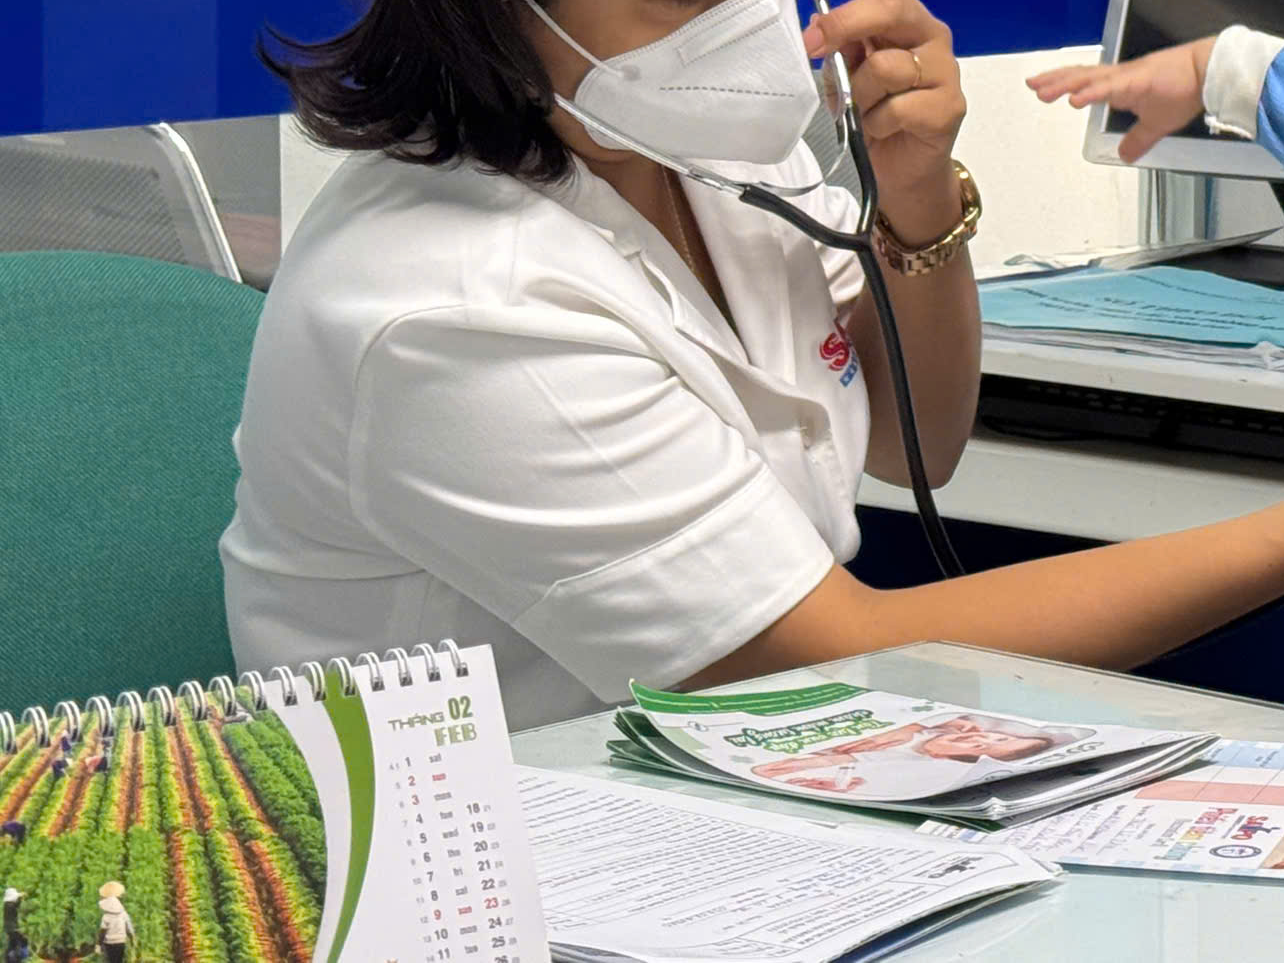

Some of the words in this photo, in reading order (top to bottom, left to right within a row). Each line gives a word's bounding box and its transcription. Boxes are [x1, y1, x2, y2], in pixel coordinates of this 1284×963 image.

[448, 695, 473, 720] 02
[434, 723, 477, 746] FEB
[405, 756, 411, 767] 1
[408, 775, 416, 786] 2
[411, 794, 420, 806] 3
[416, 813, 424, 824] 4
[466, 802, 480, 814] 18
[420, 832, 428, 844] 5
[470, 821, 484, 833] 19
[423, 852, 431, 863] 6
[473, 840, 488, 852] 20
[427, 871, 434, 882] 7
[477, 859, 491, 871] 21
[431, 890, 439, 901] 8
[481, 878, 495, 890] 22
[434, 909, 441, 920] 9
[484, 897, 498, 909] 23
[435, 928, 448, 940] 10
[488, 917, 502, 929] 24
[438, 947, 451, 960] 11
[492, 936, 505, 948] 25
